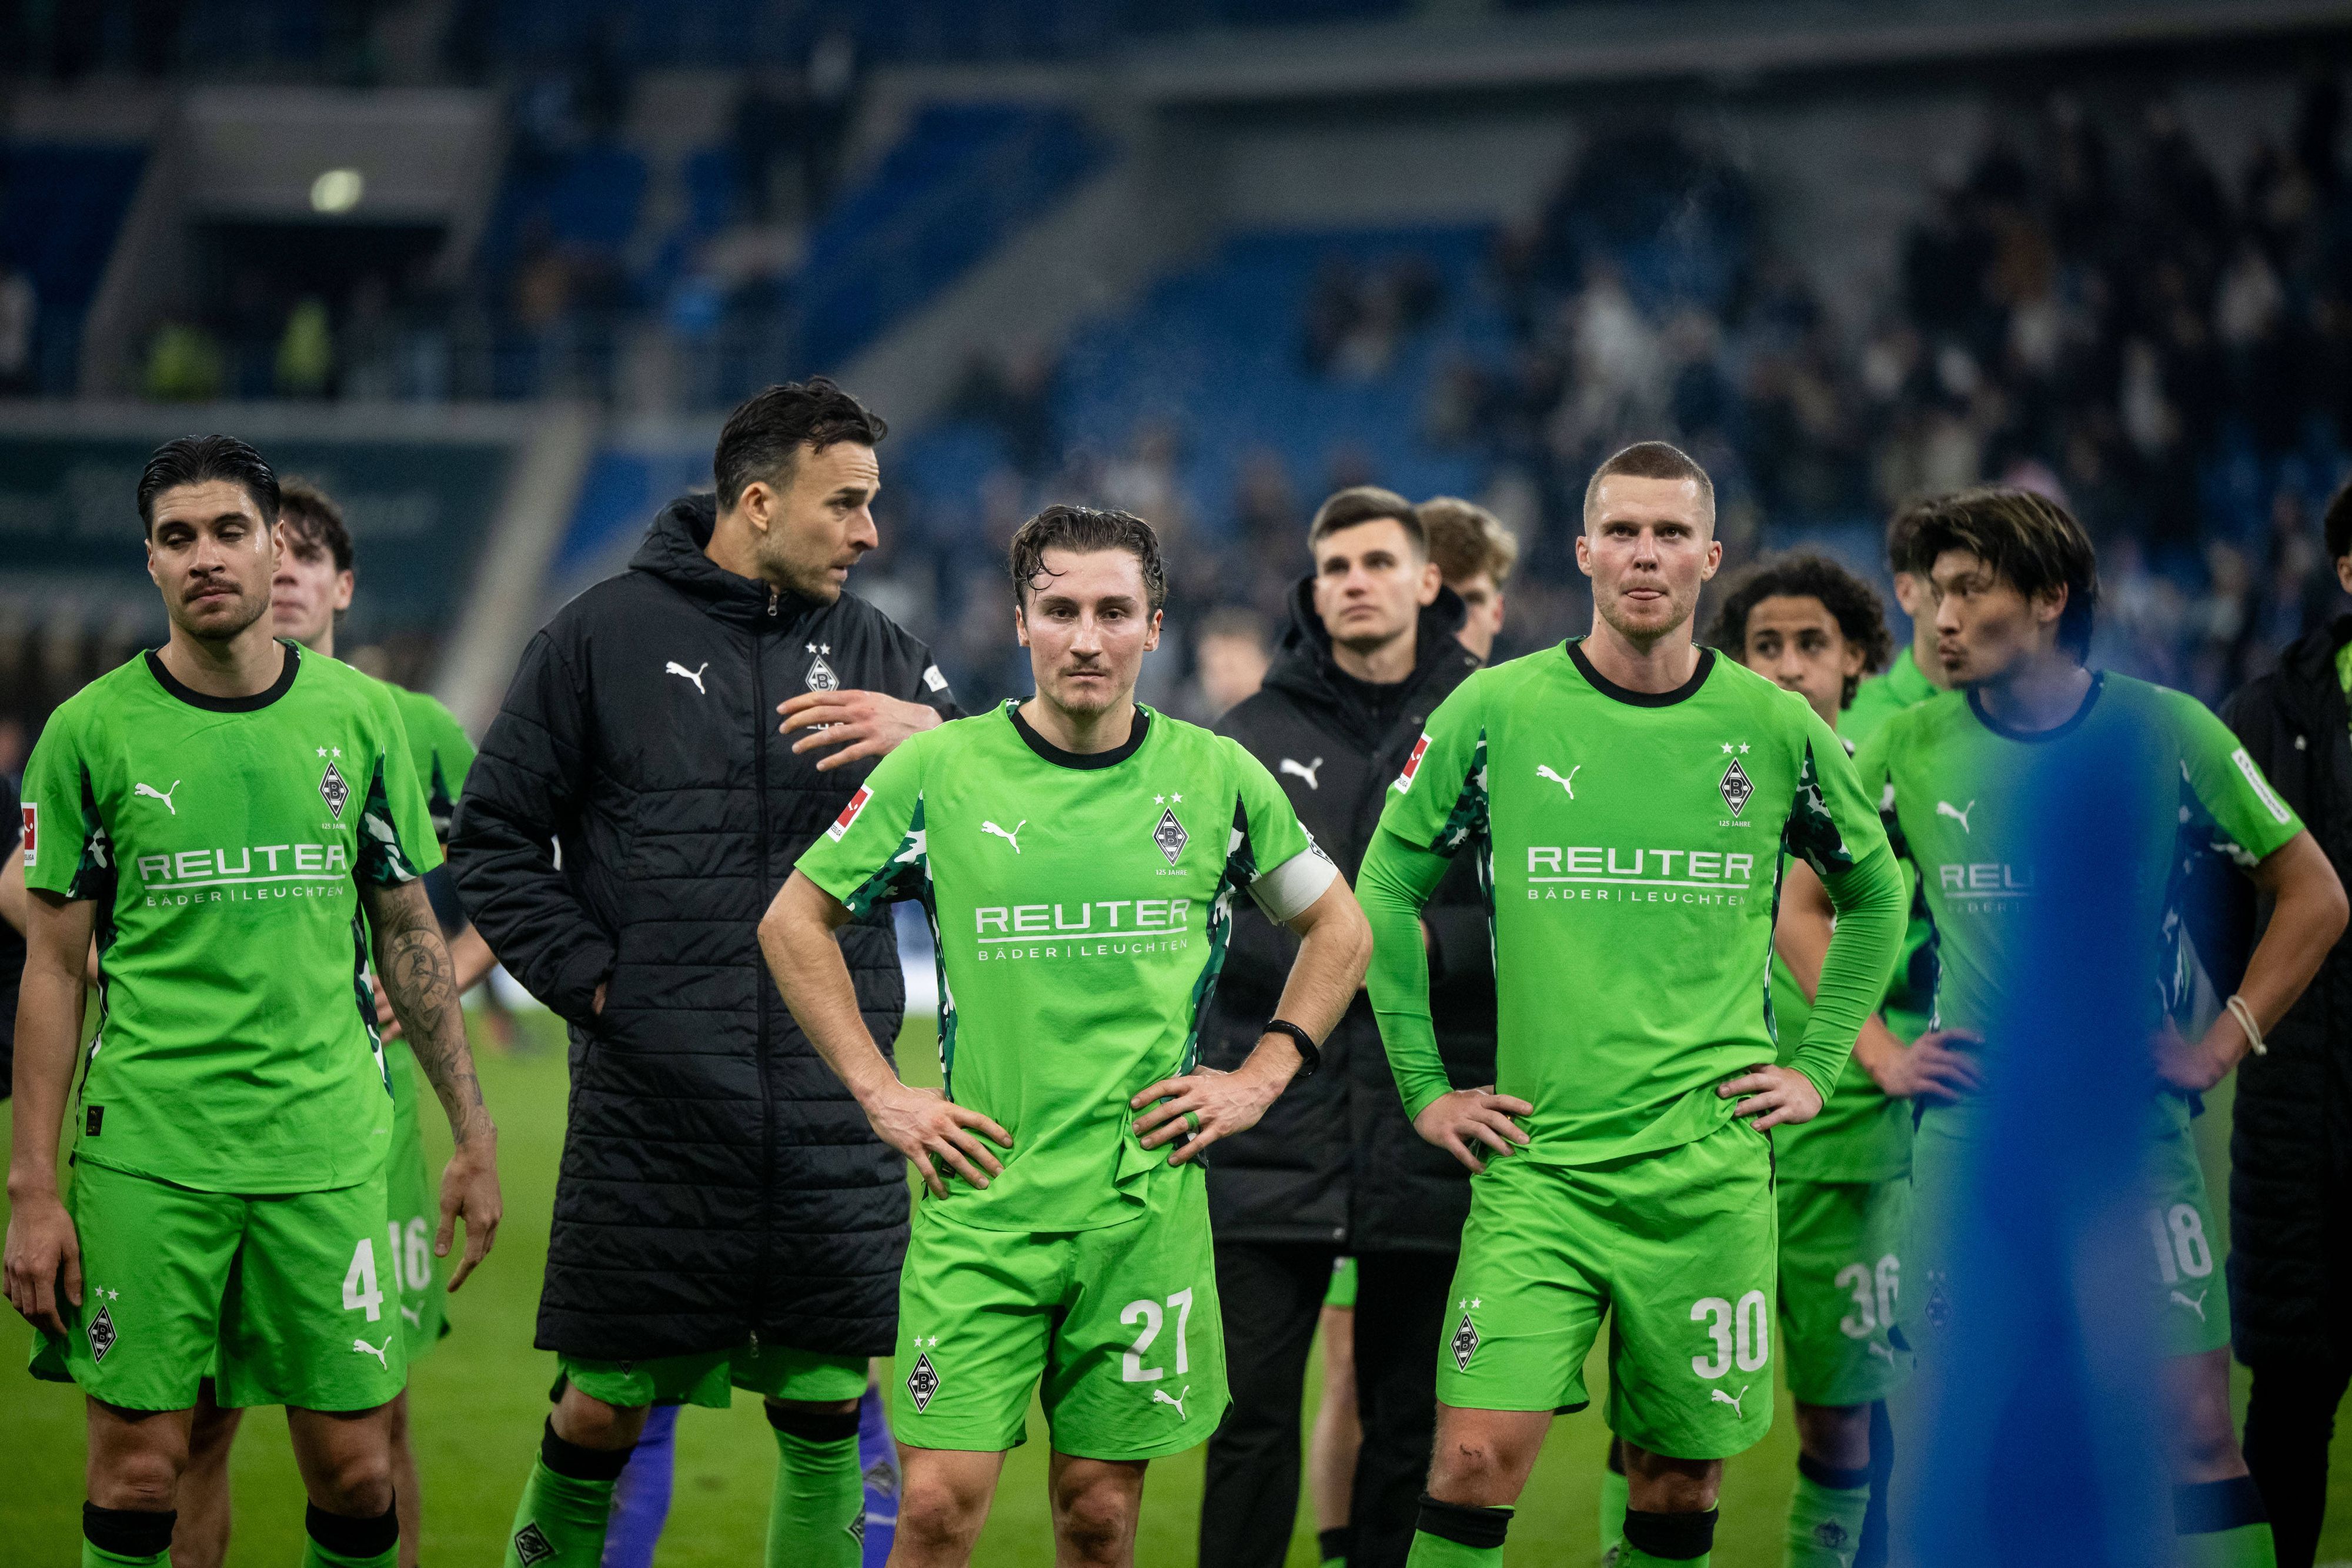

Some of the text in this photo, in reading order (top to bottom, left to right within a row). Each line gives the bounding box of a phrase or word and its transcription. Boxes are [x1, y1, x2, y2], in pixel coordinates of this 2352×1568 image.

[138, 844, 346, 881] REUTER
[1528, 847, 1753, 880] REUTER
[147, 891, 222, 907] BÄDER
[243, 886, 343, 901] LEUCHTEN
[975, 899, 1191, 934] REUTER
[1528, 887, 1608, 900] BÄDER
[1631, 891, 1745, 906] LEUCHTEN
[978, 947, 1057, 961] BÄDER
[1081, 939, 1187, 957] LEUCHTEN
[388, 1216, 431, 1293] 16
[2151, 1203, 2213, 1282] 18
[342, 1238, 383, 1322] 4
[1834, 1253, 1900, 1339] 36
[1120, 1287, 1192, 1382] 27
[1690, 1290, 1768, 1379] 30
